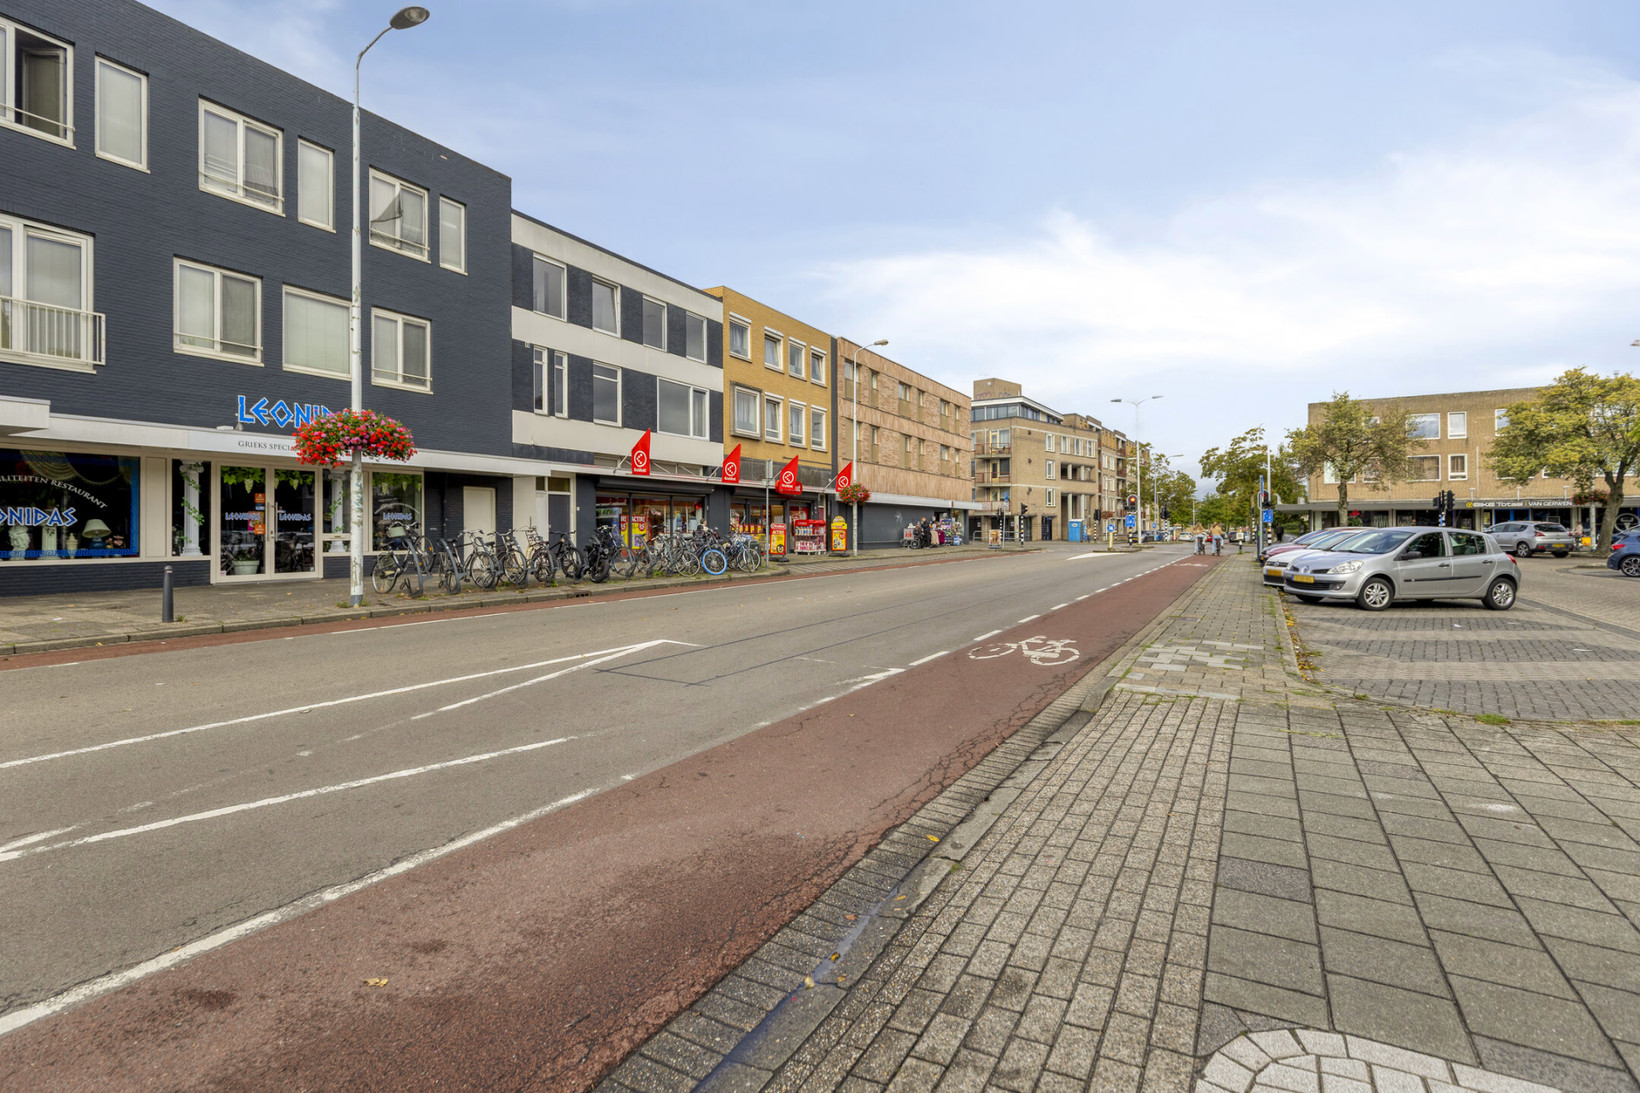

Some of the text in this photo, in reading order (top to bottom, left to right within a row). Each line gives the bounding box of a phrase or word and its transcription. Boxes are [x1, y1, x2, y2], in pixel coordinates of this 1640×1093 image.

[238, 440, 267, 449] GRIEKS
[51, 479, 108, 509] RESTAURANT
[225, 512, 260, 521] LEONIDAS
[279, 513, 312, 521] LEONIDAS
[382, 512, 412, 521] LEONIDAS
